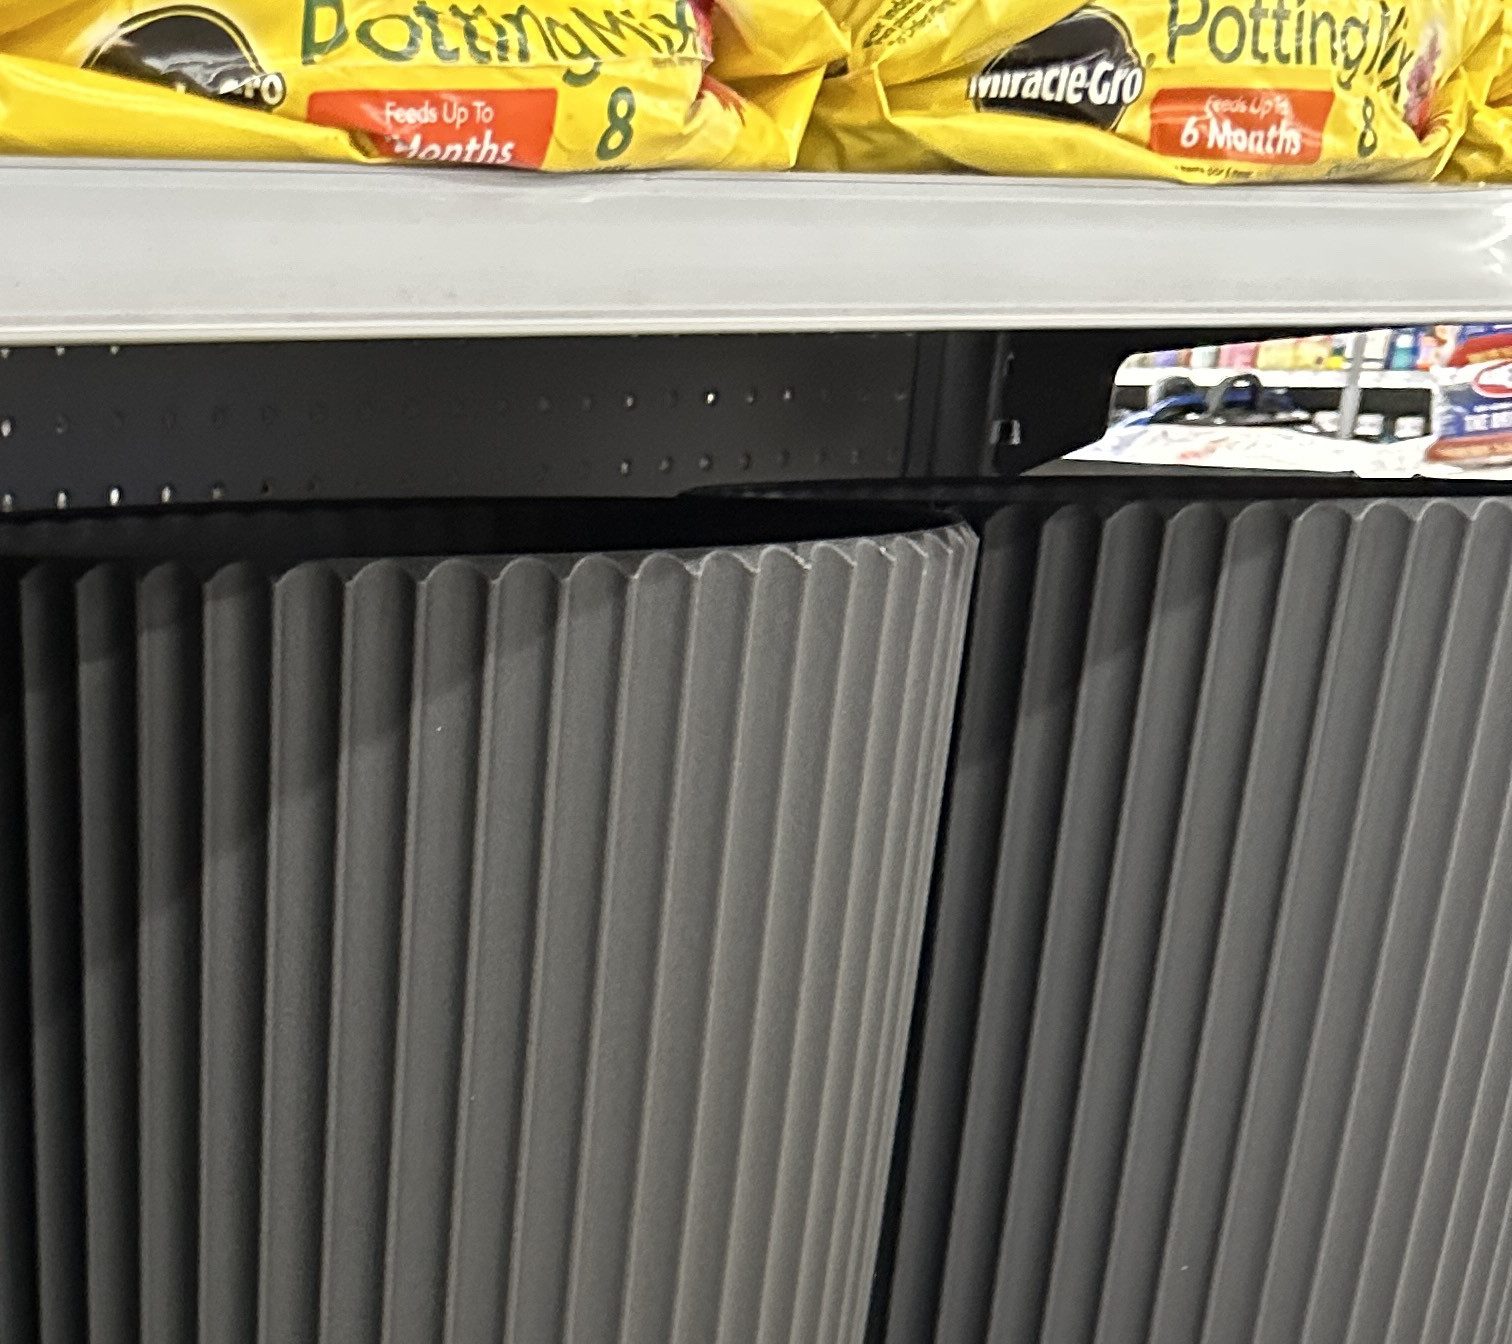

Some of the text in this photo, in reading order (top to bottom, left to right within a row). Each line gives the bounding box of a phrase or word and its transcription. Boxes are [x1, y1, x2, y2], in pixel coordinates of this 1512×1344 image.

[301, 0, 602, 87] Potting
[1167, 0, 1370, 91] Potting
[385, 101, 495, 130] Feeds Up To
[596, 86, 636, 161] 8
[1179, 116, 1302, 155] 6 Months
[1357, 96, 1378, 158] 8
